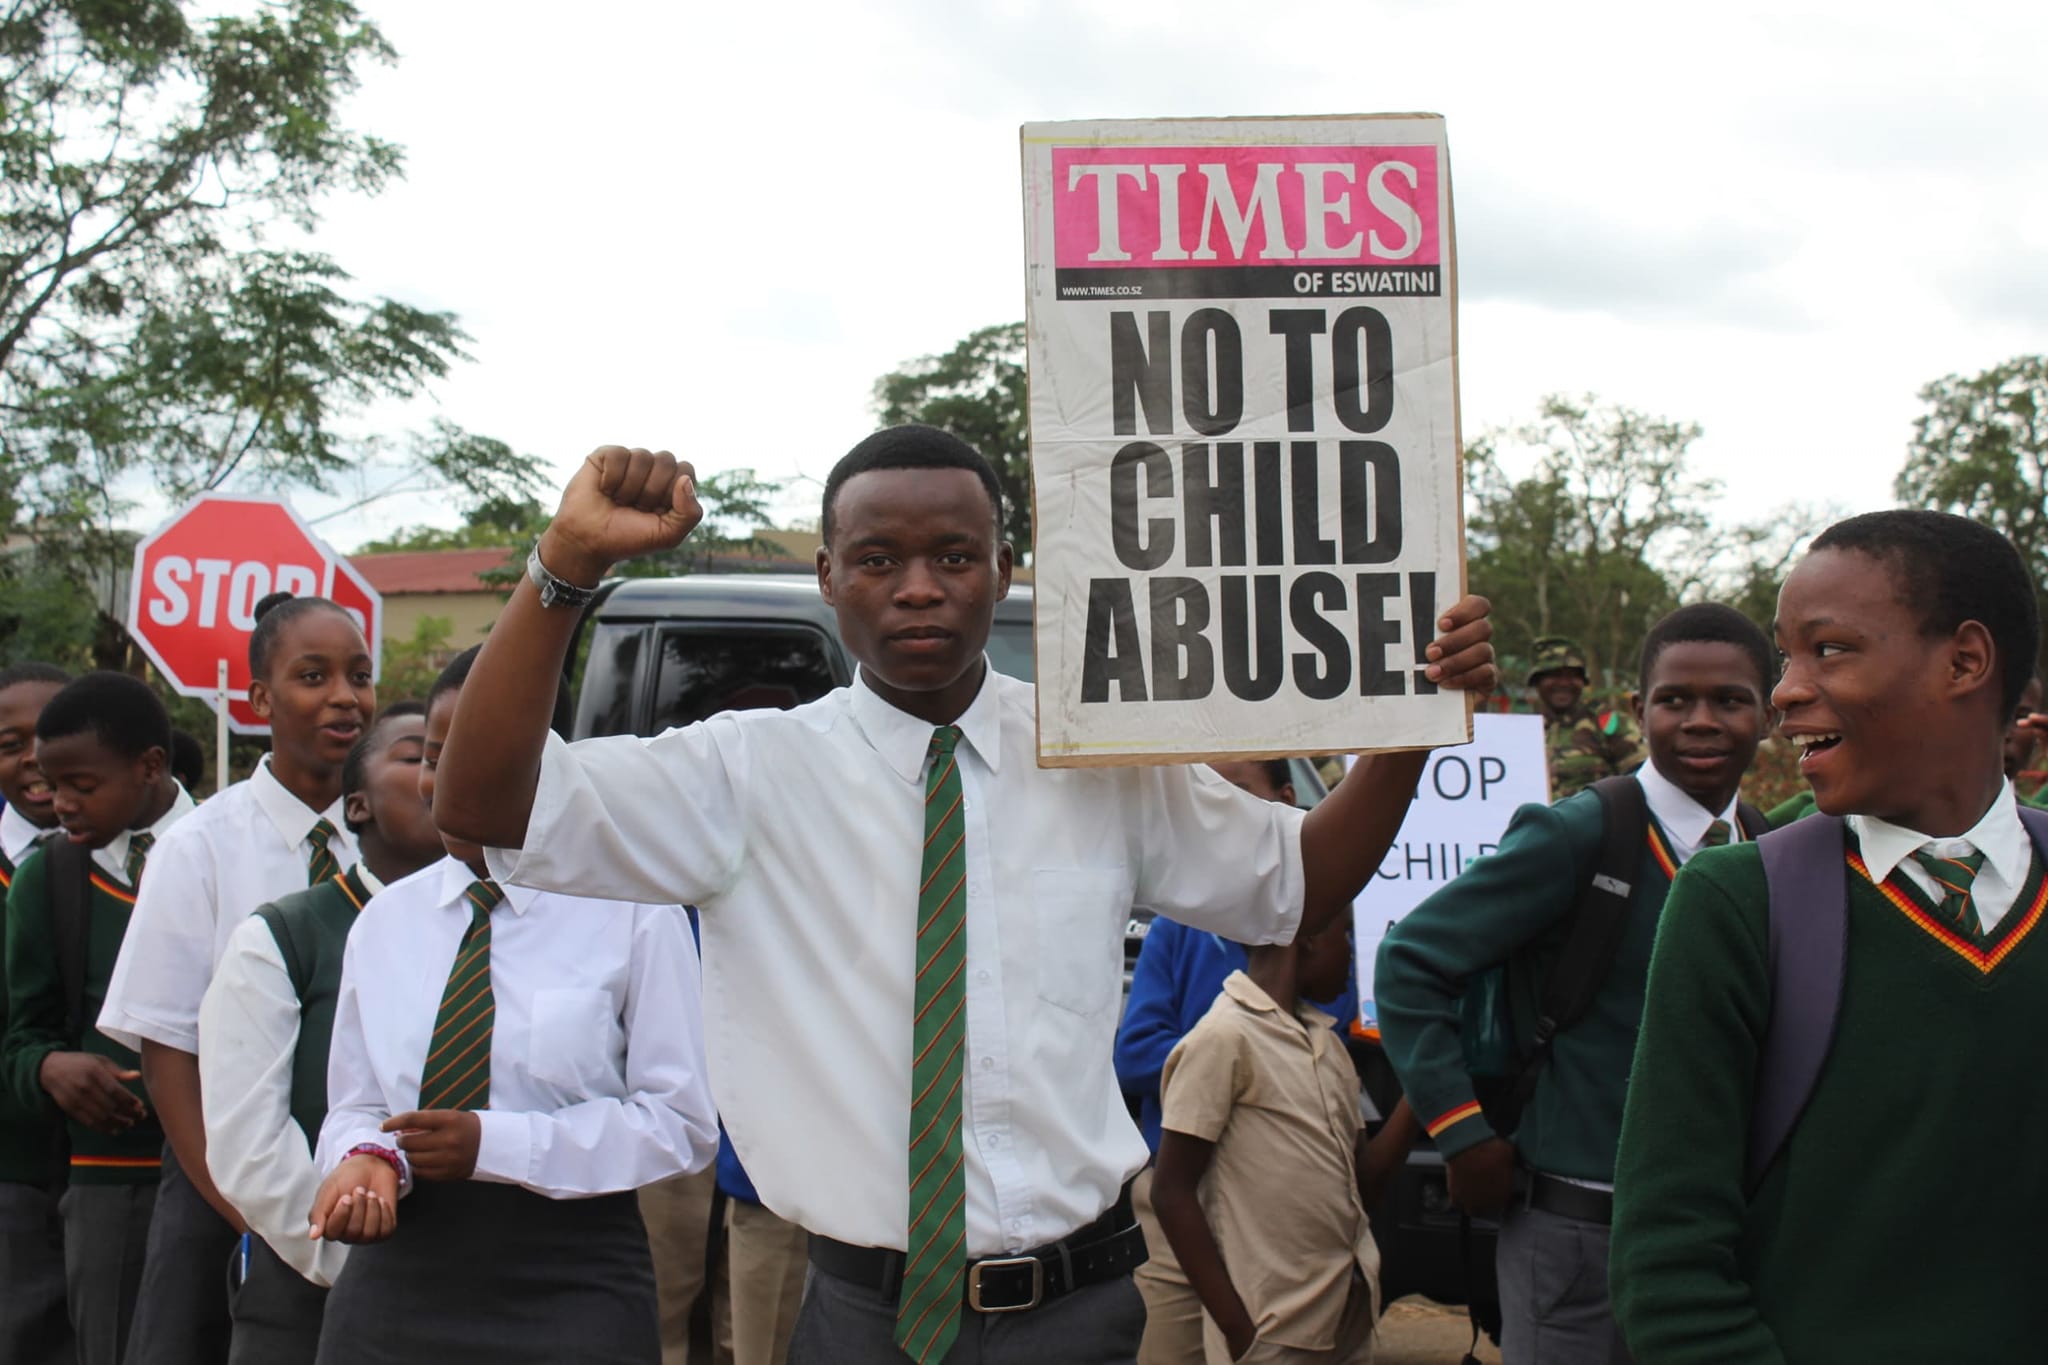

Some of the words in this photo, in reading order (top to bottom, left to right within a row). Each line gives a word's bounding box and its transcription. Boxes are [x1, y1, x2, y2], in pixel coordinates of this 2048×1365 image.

[1069, 161, 1422, 261] TIMES
[1063, 286, 1142, 296] WWW.TIMES.CO.SZ
[1294, 273, 1324, 293] OF
[1332, 272, 1434, 292] ESWATINI
[1110, 307, 1244, 436] NO
[1269, 306, 1394, 434] TO
[1110, 440, 1403, 570] CHILD
[1081, 571, 1439, 703] ABUSE!
